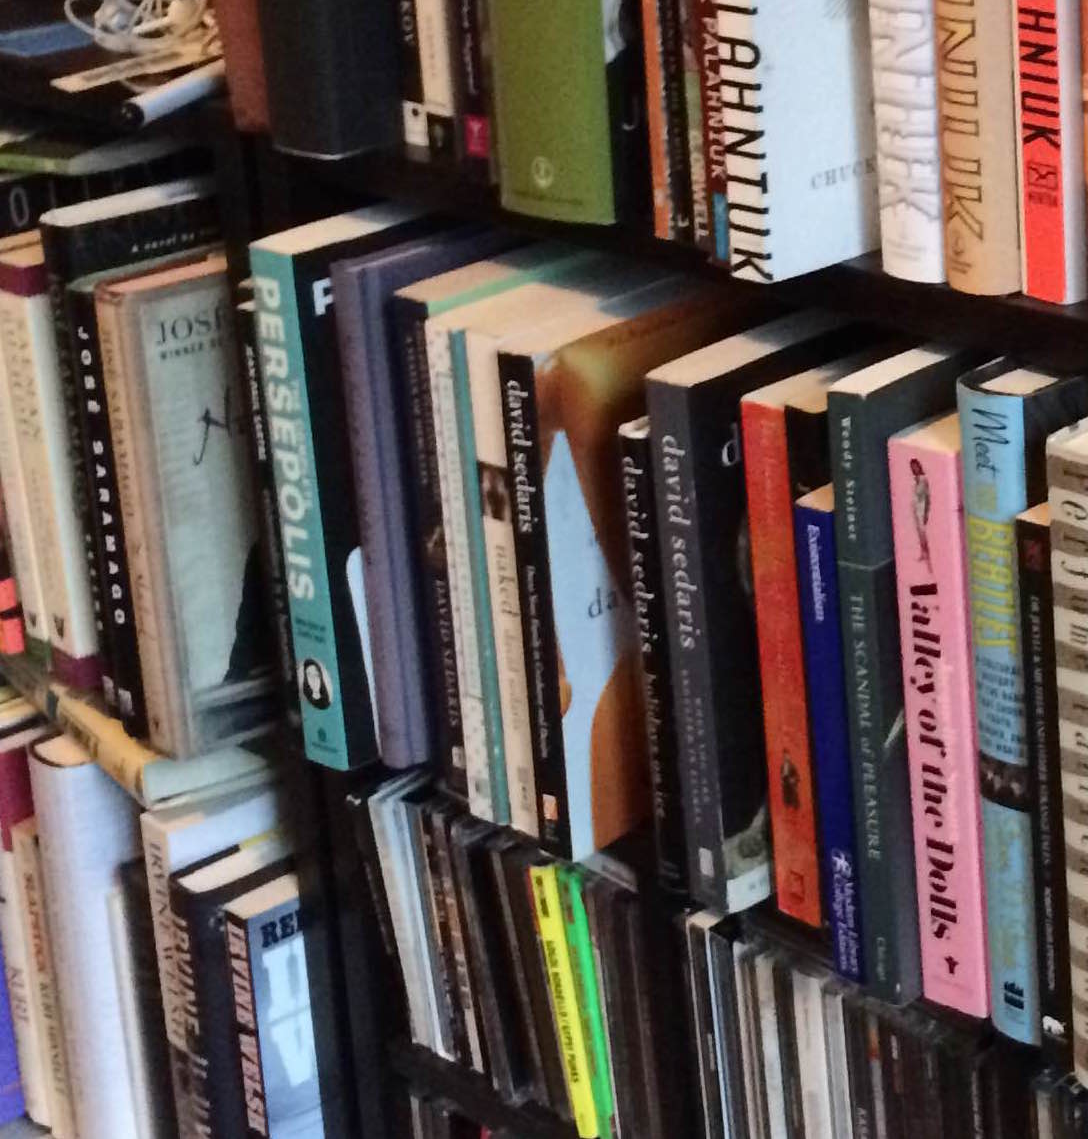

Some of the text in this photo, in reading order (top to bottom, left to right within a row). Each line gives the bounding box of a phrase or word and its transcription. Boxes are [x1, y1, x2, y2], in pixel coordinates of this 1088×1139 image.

[701, 15, 728, 181] PALAHNIUK
[254, 273, 316, 601] PERSEPOLIS
[503, 378, 538, 443] david
[969, 406, 1013, 480] Meet
[511, 452, 541, 534] sedaris
[620, 456, 649, 540] david
[660, 434, 697, 525] david
[839, 415, 863, 542] Wendy Steiner
[90, 440, 127, 625] SARAMAGO
[494, 544, 520, 619] naked
[807, 524, 830, 623] Existentialism
[628, 550, 660, 654] sedaris
[671, 536, 704, 653] sedaris
[967, 516, 1019, 657] BEATLES
[434, 581, 462, 728] DAVID SEDARIS
[908, 580, 944, 706] Valley
[848, 593, 883, 859] THE SCANDAL of PLEASURE
[914, 707, 949, 760] of
[920, 761, 954, 829] the
[925, 837, 959, 941] Dolls
[226, 921, 256, 1036] IRVINE
